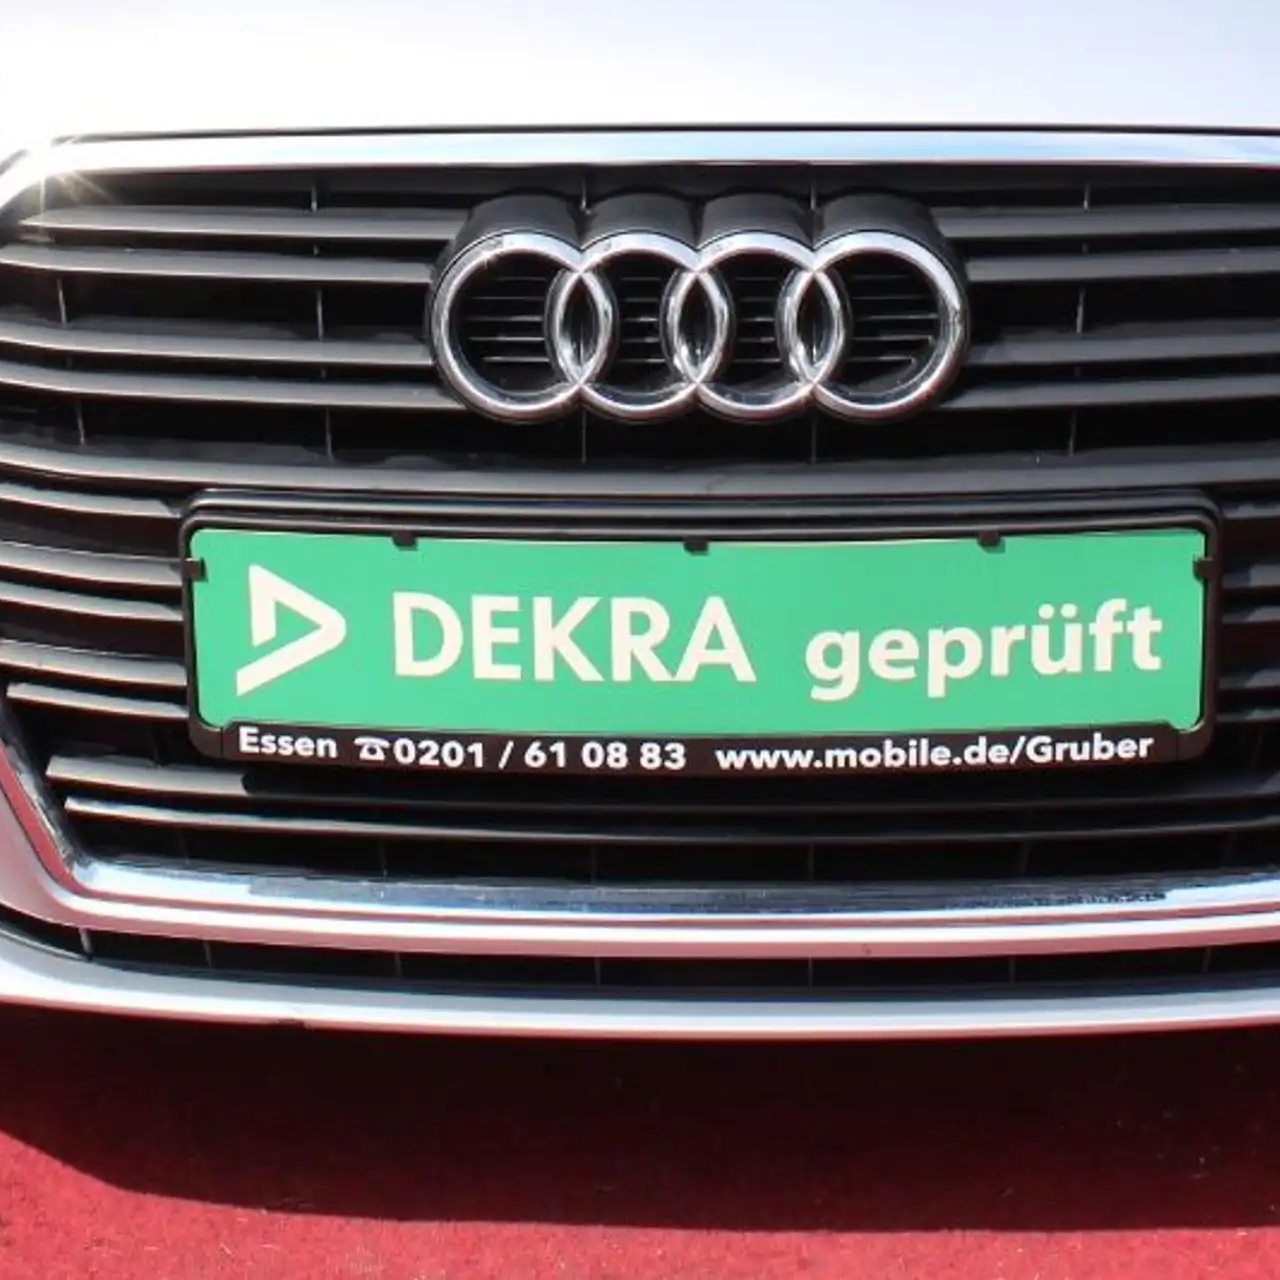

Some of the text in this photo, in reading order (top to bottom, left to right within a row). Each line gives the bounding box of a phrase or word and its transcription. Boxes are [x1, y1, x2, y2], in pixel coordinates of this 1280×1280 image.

[392, 591, 1163, 701] DEKRA geprüft
[238, 726, 338, 759] Essen
[524, 740, 567, 768] 61
[581, 741, 628, 770] 08
[640, 741, 687, 770] 83
[714, 733, 1156, 771] www.mobile.de/Gruber
